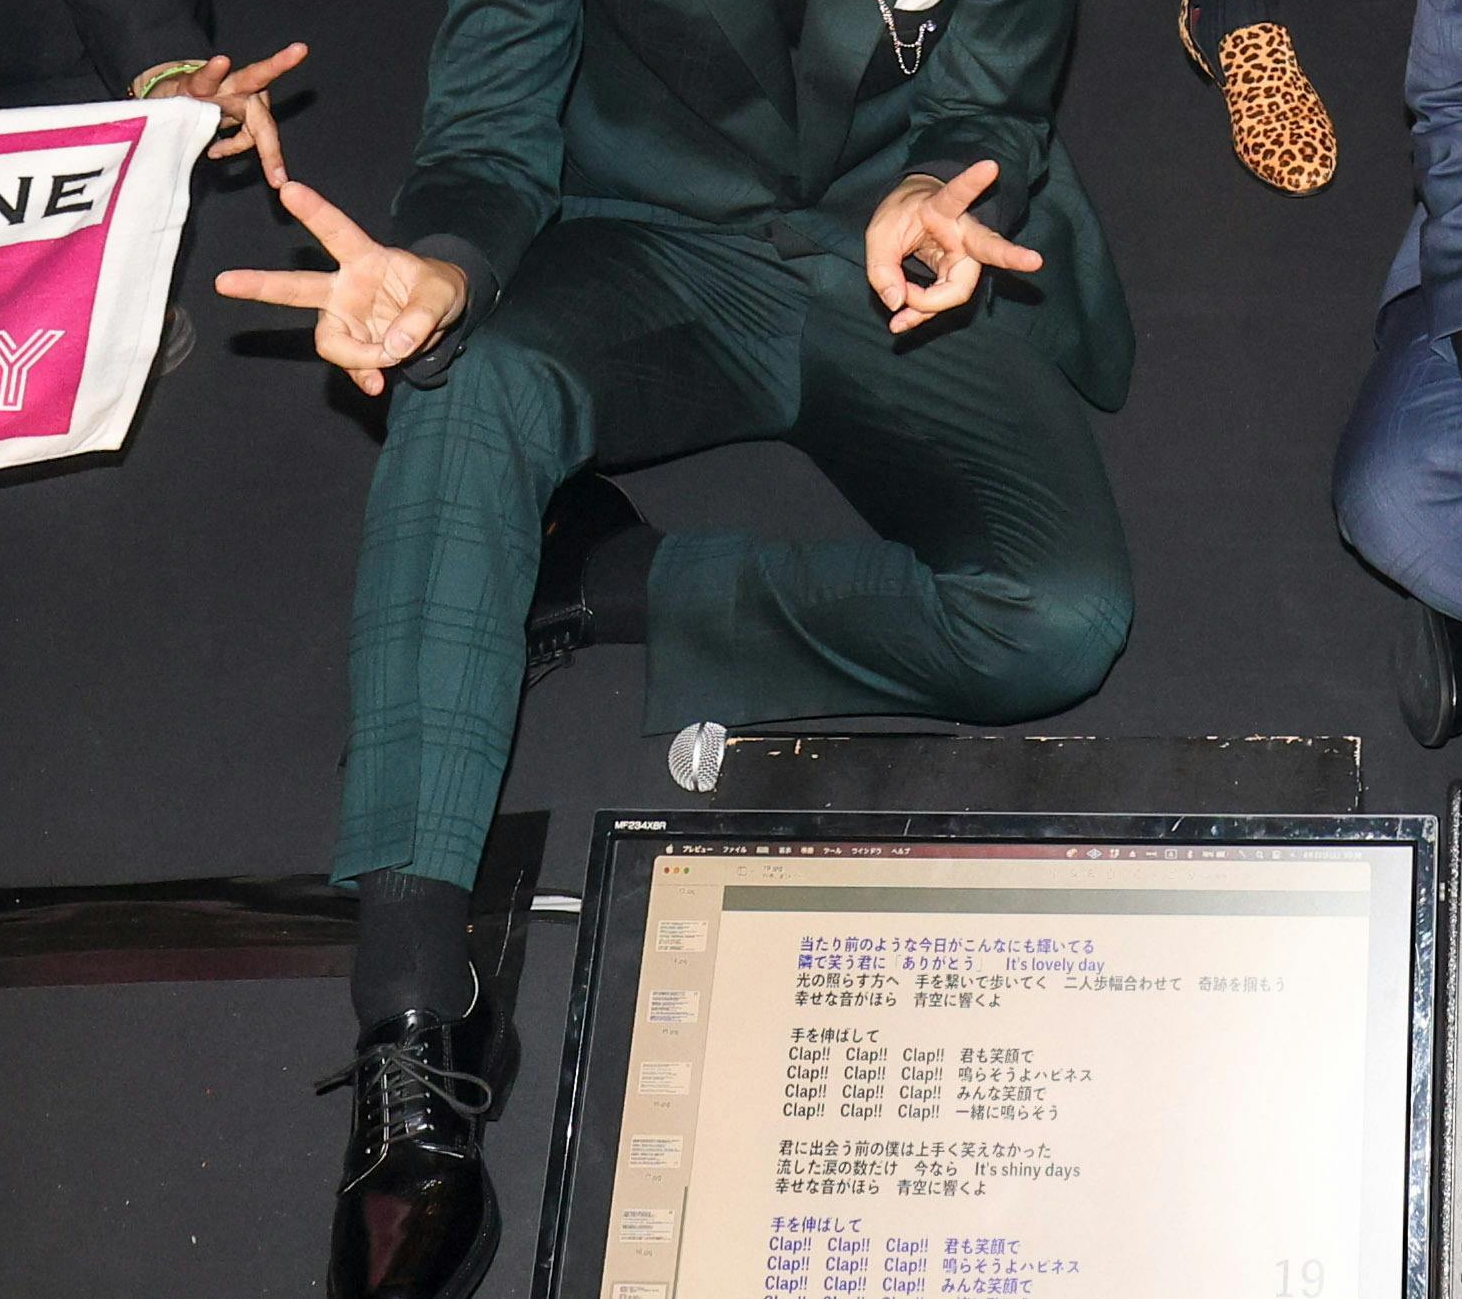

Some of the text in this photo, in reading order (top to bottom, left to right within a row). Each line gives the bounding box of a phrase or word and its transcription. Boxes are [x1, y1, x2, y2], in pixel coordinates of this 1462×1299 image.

[1006, 958, 1027, 971] It's
[1031, 957, 1075, 973] lovely
[1078, 958, 1105, 974] day
[796, 973, 900, 989] 光の照らす方へ
[794, 991, 1001, 1008] 幸せな音がほら 青空に響くよ
[791, 1028, 879, 1043] 手を伸ばして
[789, 1047, 1034, 1064] Clap!! Clap!! Clap!! 君も笑顔で
[783, 1104, 1058, 1121] Clap!! Clap!! Clap!! 一緒に鳴らそう
[778, 1140, 1051, 1158] 君に出会う前の僕は上手く笑えなかった
[777, 1160, 1080, 1179] 流した涙の数だけ 今なら It's shiny days
